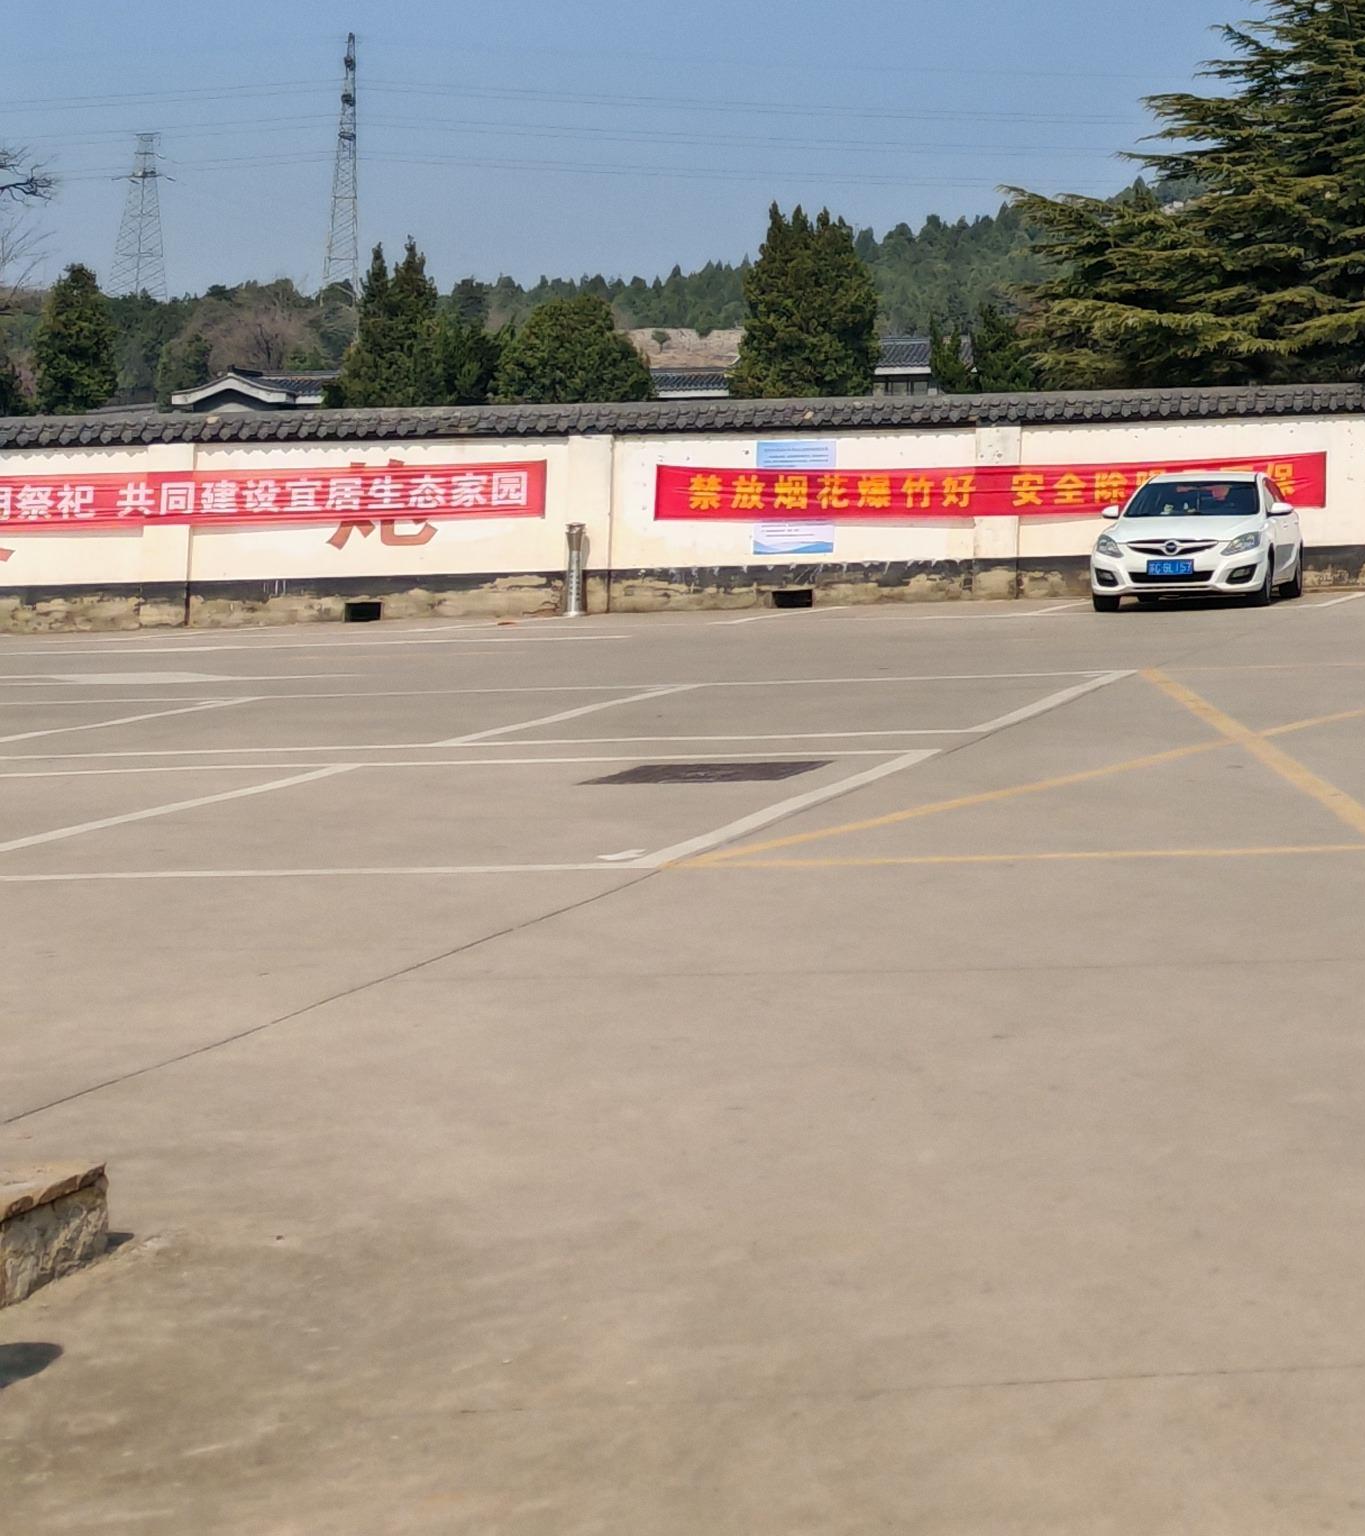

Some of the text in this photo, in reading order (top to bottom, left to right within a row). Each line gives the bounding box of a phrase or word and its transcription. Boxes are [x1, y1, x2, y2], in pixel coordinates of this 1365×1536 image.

[0, 483, 97, 521] 祭祀
[116, 471, 528, 518] 共同建设宜居生态家园
[688, 474, 977, 510] 禁放烟花爆竹好
